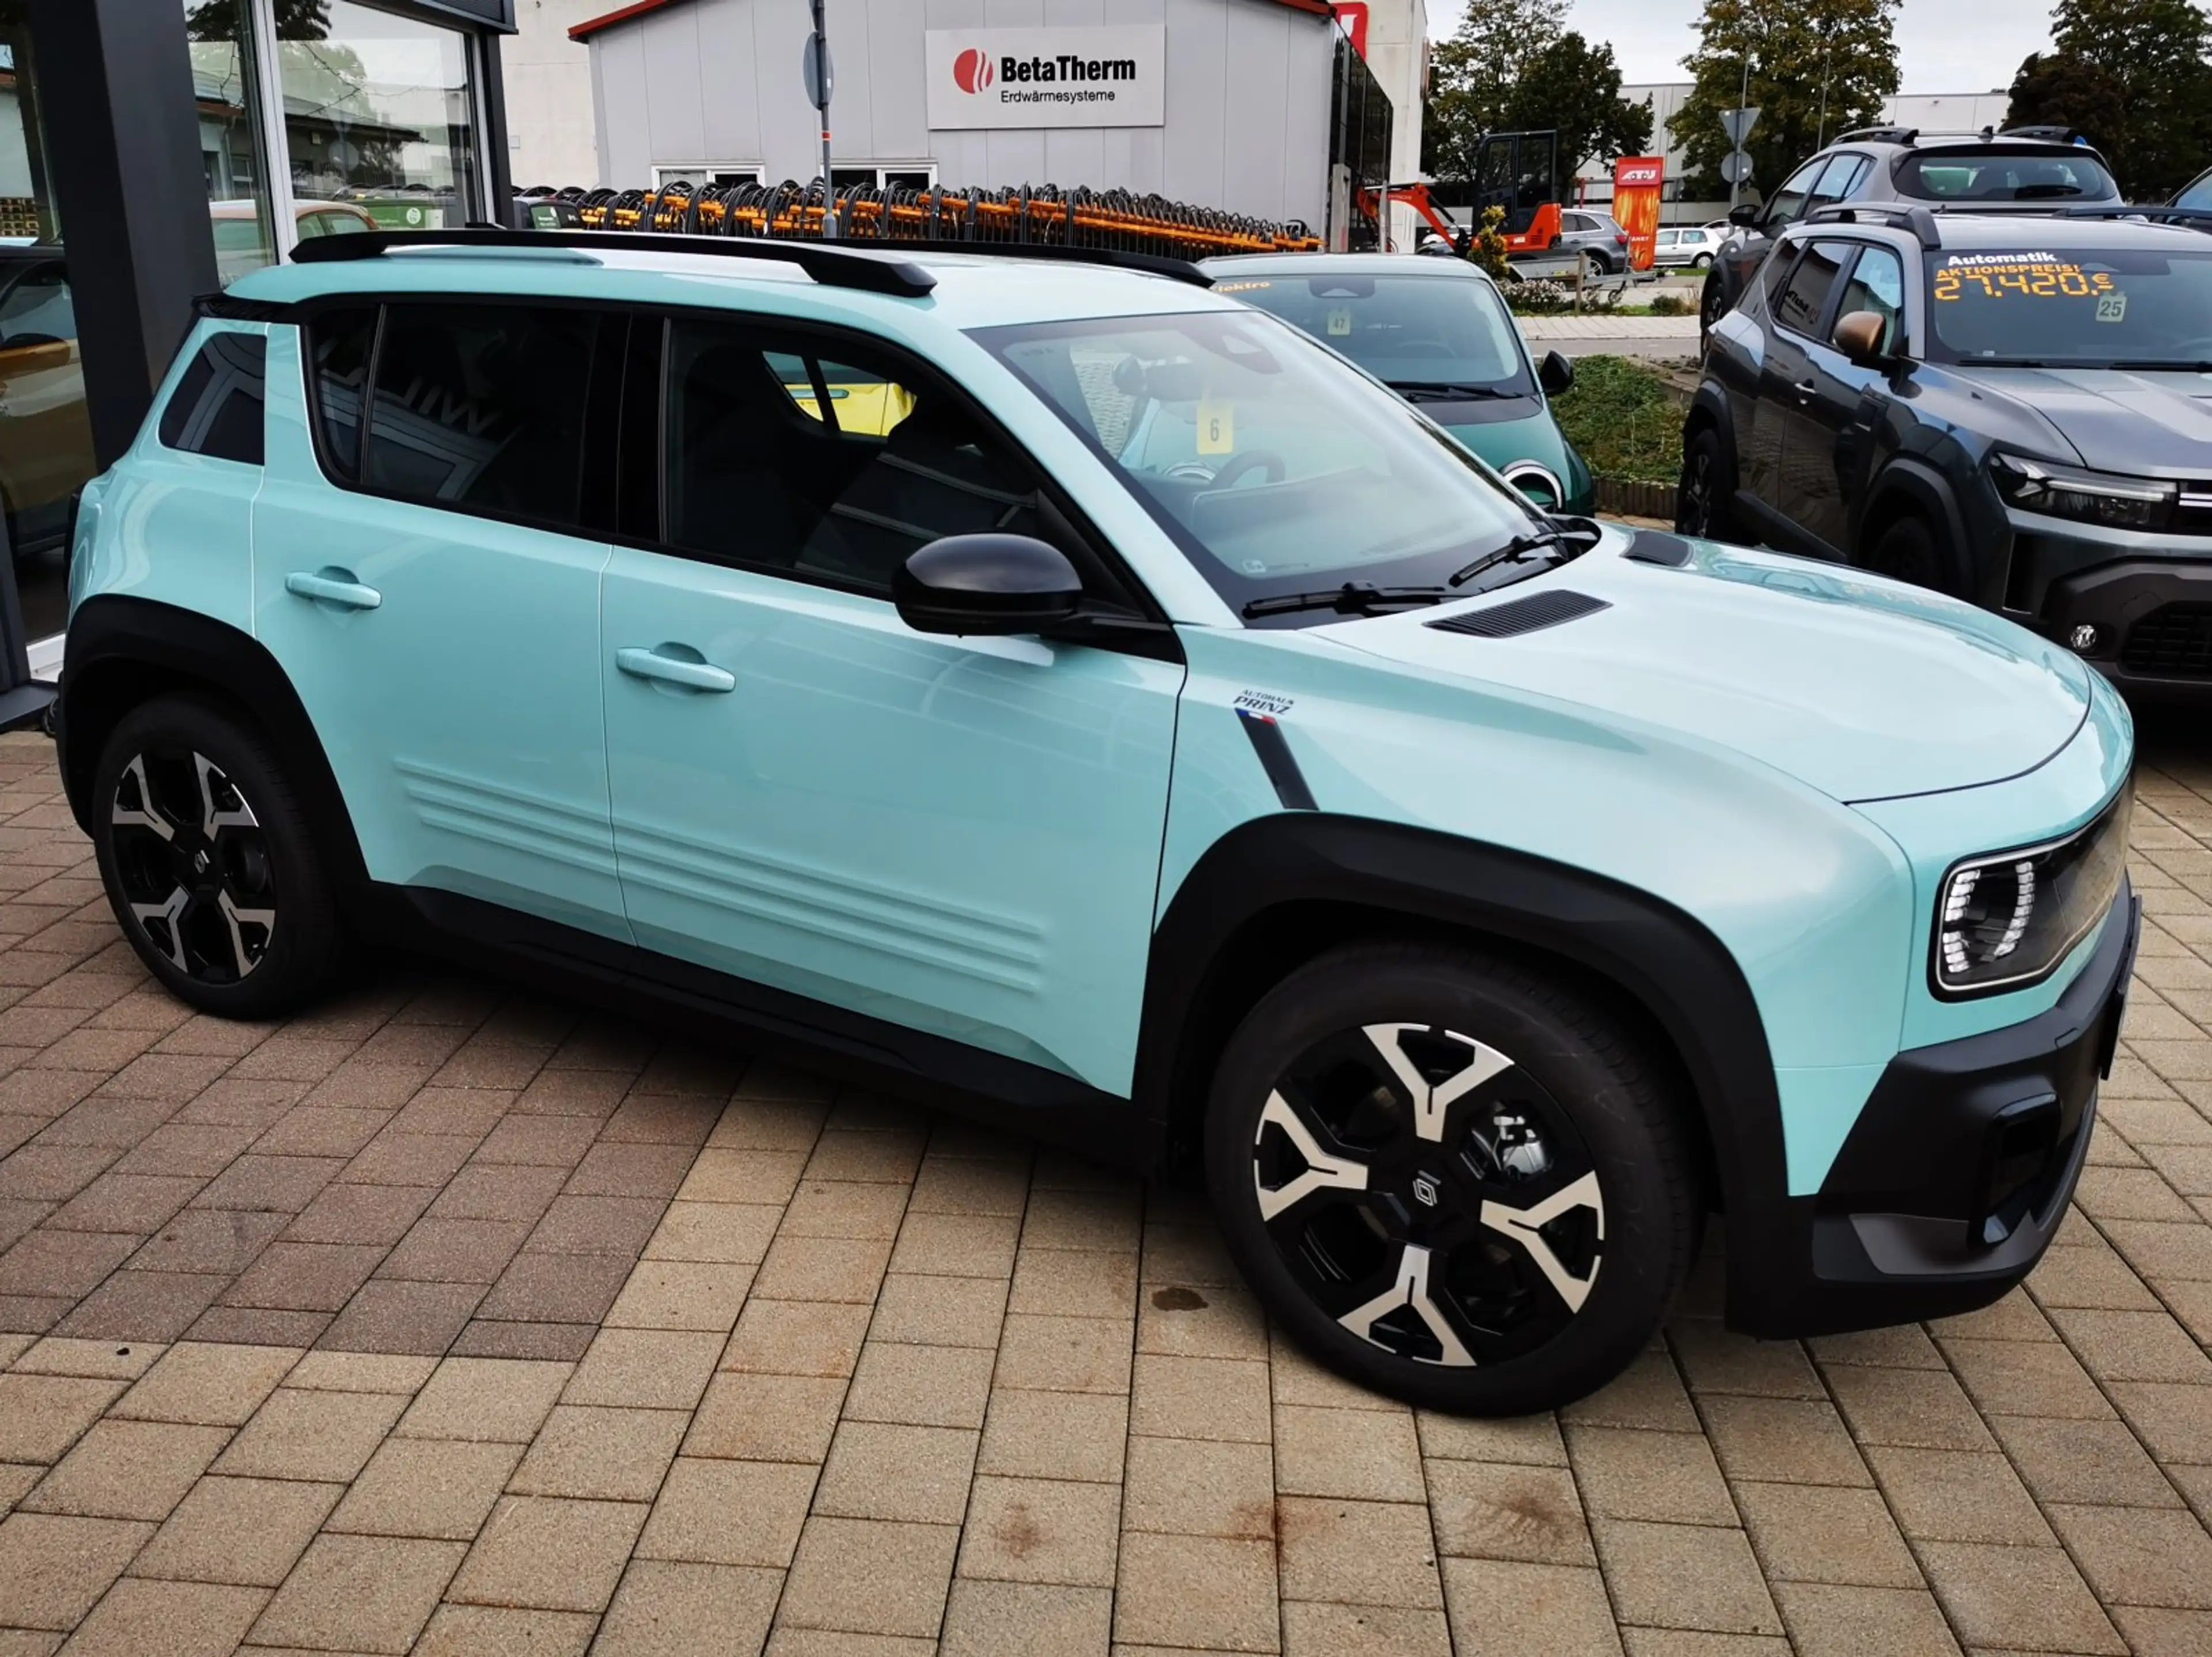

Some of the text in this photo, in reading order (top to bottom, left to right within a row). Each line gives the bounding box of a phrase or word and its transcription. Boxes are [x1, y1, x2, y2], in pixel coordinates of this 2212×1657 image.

[1001, 55, 1136, 82] BetaTherm
[1001, 90, 1115, 104] Erdwärmesysteme
[1948, 252, 2058, 266] Automatik
[1936, 264, 2081, 276] AKTIONSPREIS!
[2099, 301, 2123, 317] 25
[1333, 318, 1346, 331] 47
[1210, 418, 1219, 443] 6
[1233, 696, 1291, 715] PRINZ
